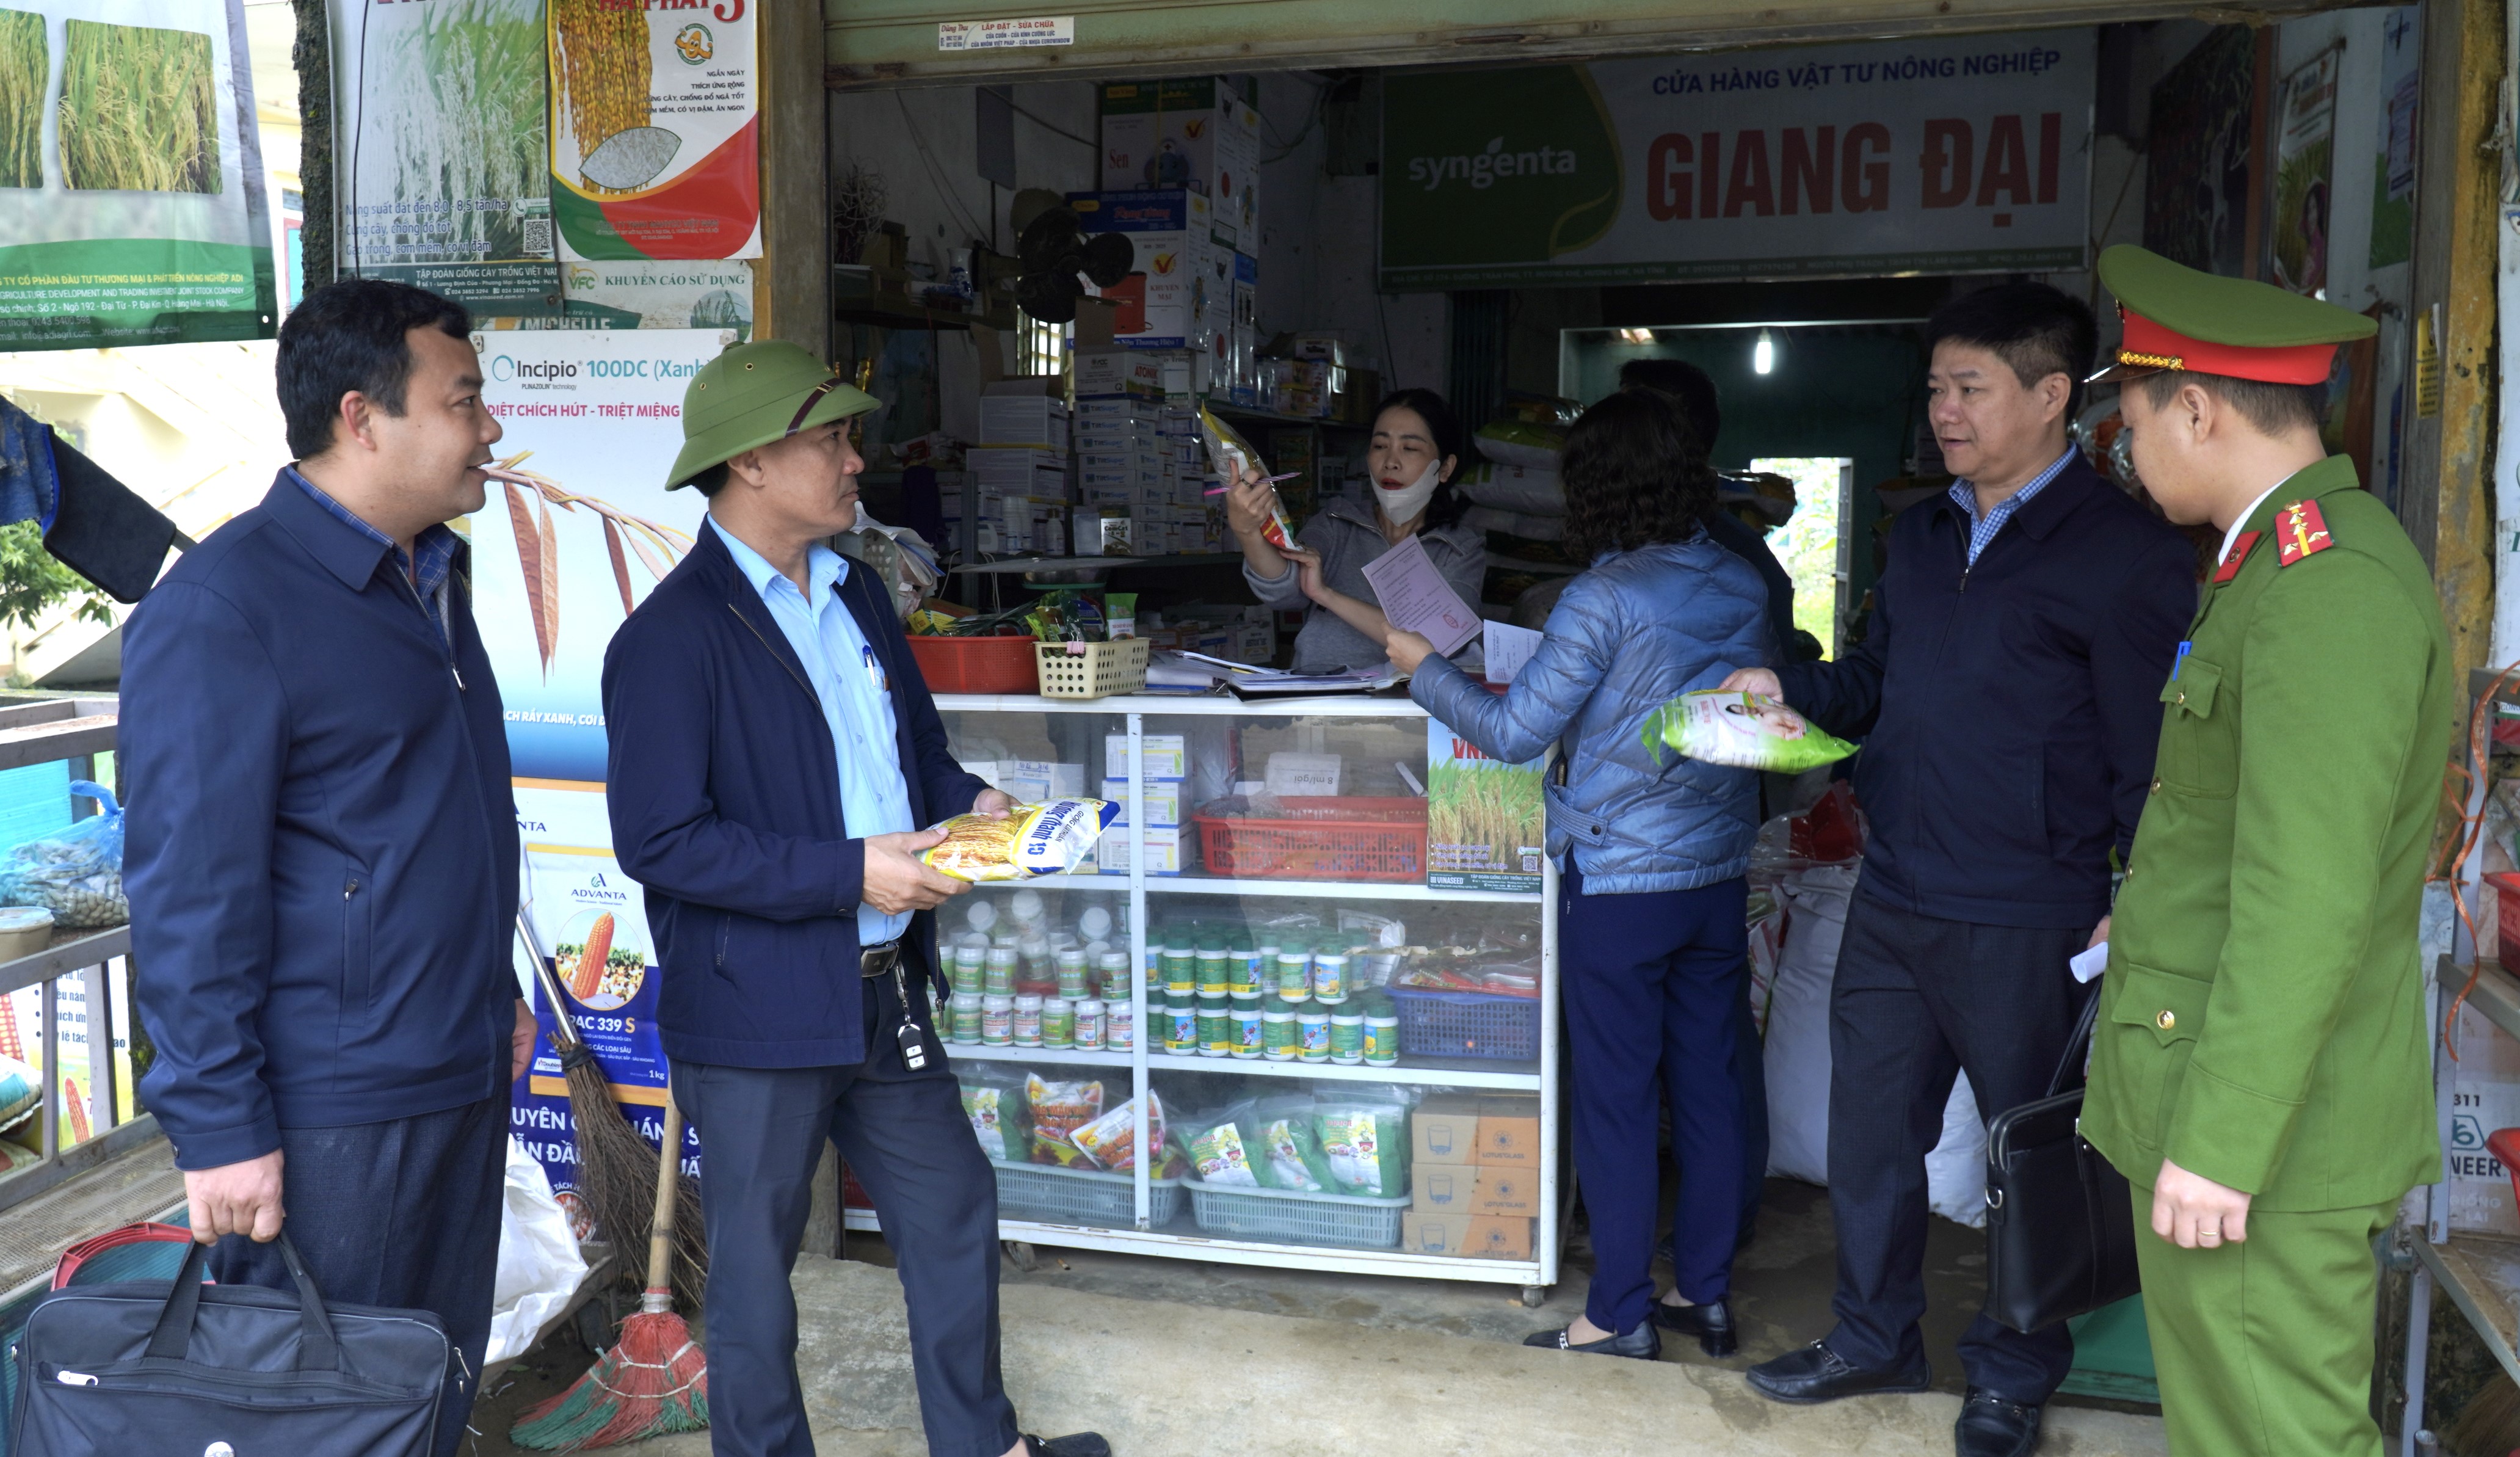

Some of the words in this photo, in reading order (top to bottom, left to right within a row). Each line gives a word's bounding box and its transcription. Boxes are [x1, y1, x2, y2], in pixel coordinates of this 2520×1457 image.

[997, 22, 1011, 31] ĐẶT
[1653, 68, 1703, 95] CỬA
[1710, 68, 1779, 93] HÀNG
[1787, 63, 1836, 91] VẬT
[1840, 62, 1881, 84] TƯ
[1883, 56, 1954, 81] NÔNG
[1963, 48, 2061, 77] NGHIỆP
[727, 81, 745, 90] RỘNG
[680, 92, 703, 101] CHỐNG
[732, 91, 744, 100] TỐT
[1109, 148, 1128, 169] Sen
[1409, 145, 1577, 192] syngenta
[1647, 122, 1892, 222] GIANG
[1919, 112, 2062, 228] ĐẠI
[346, 204, 369, 217] Nng
[372, 201, 393, 214] suất
[395, 203, 411, 216] đạt
[414, 200, 431, 213] đến
[434, 201, 449, 213] 8,0
[457, 200, 472, 212] 8,5
[474, 197, 508, 211] tấn/ha
[346, 225, 368, 237] Cng
[371, 223, 389, 236] cây,
[391, 220, 420, 236] chống
[423, 218, 435, 233] đổ
[437, 219, 452, 233] tốt
[366, 244, 393, 256] trong,
[396, 244, 415, 254] cơm
[418, 239, 445, 254] mềm,
[447, 242, 457, 253] có
[459, 244, 470, 255] vị
[471, 240, 492, 253] đậm
[4, 277, 15, 285] TY
[18, 274, 31, 285] CỔ
[32, 273, 59, 285] PHẦN
[61, 273, 79, 284] ĐẦU
[81, 274, 93, 284] TƯ
[93, 274, 128, 283] THƯƠNG
[130, 274, 146, 285] MẠI
[153, 272, 167, 283] PHÁT
[168, 272, 184, 283] TRIỂN
[186, 272, 203, 282] NÔNG
[205, 272, 229, 284] NGHIỆP
[416, 269, 431, 279] TẬP
[432, 267, 454, 278] ĐOÀN
[456, 266, 479, 278] GIỐNG
[481, 267, 496, 277] CÂY
[498, 265, 523, 277] TRỒNG
[526, 265, 540, 277] VIỆT
[568, 275, 595, 290] VFC
[660, 273, 686, 285] CÁO
[689, 272, 707, 285] SỬ
[710, 274, 745, 287] DỤNG
[0, 290, 47, 300] GRICULTURE
[48, 289, 100, 299] DEVELOPMENT
[120, 288, 148, 296] TRADING
[12, 304, 35, 313] chính:
[37, 302, 49, 312] Số
[51, 303, 57, 312] 2
[64, 303, 79, 313] Ngõ
[82, 302, 95, 311] 192
[101, 302, 114, 312] Đại
[115, 300, 126, 310] Từ
[140, 300, 151, 310] Đại
[1, 332, 18, 341] mail:
[587, 360, 648, 377] 100DC
[1135, 365, 1158, 379] ATONIK
[488, 402, 514, 420] DIỆT
[517, 401, 557, 416] CHÍCH
[561, 402, 587, 416] HÚT
[598, 402, 632, 420] TRIỆT
[637, 402, 680, 420] MIỆNG
[542, 712, 576, 726] XANH,
[1294, 774, 1325, 785] ml/gói
[572, 889, 627, 900] ADVANTA
[598, 1017, 622, 1032] 339
[625, 1017, 635, 1033] S
[62, 1030, 70, 1044] lệ
[72, 1031, 89, 1044] tác
[605, 1045, 619, 1055] LOẠI
[619, 1045, 631, 1054] SÂU
[512, 1106, 565, 1130] UYÊN
[2451, 1156, 2502, 1177] NEER
[554, 1182, 573, 1191] TÁCH
